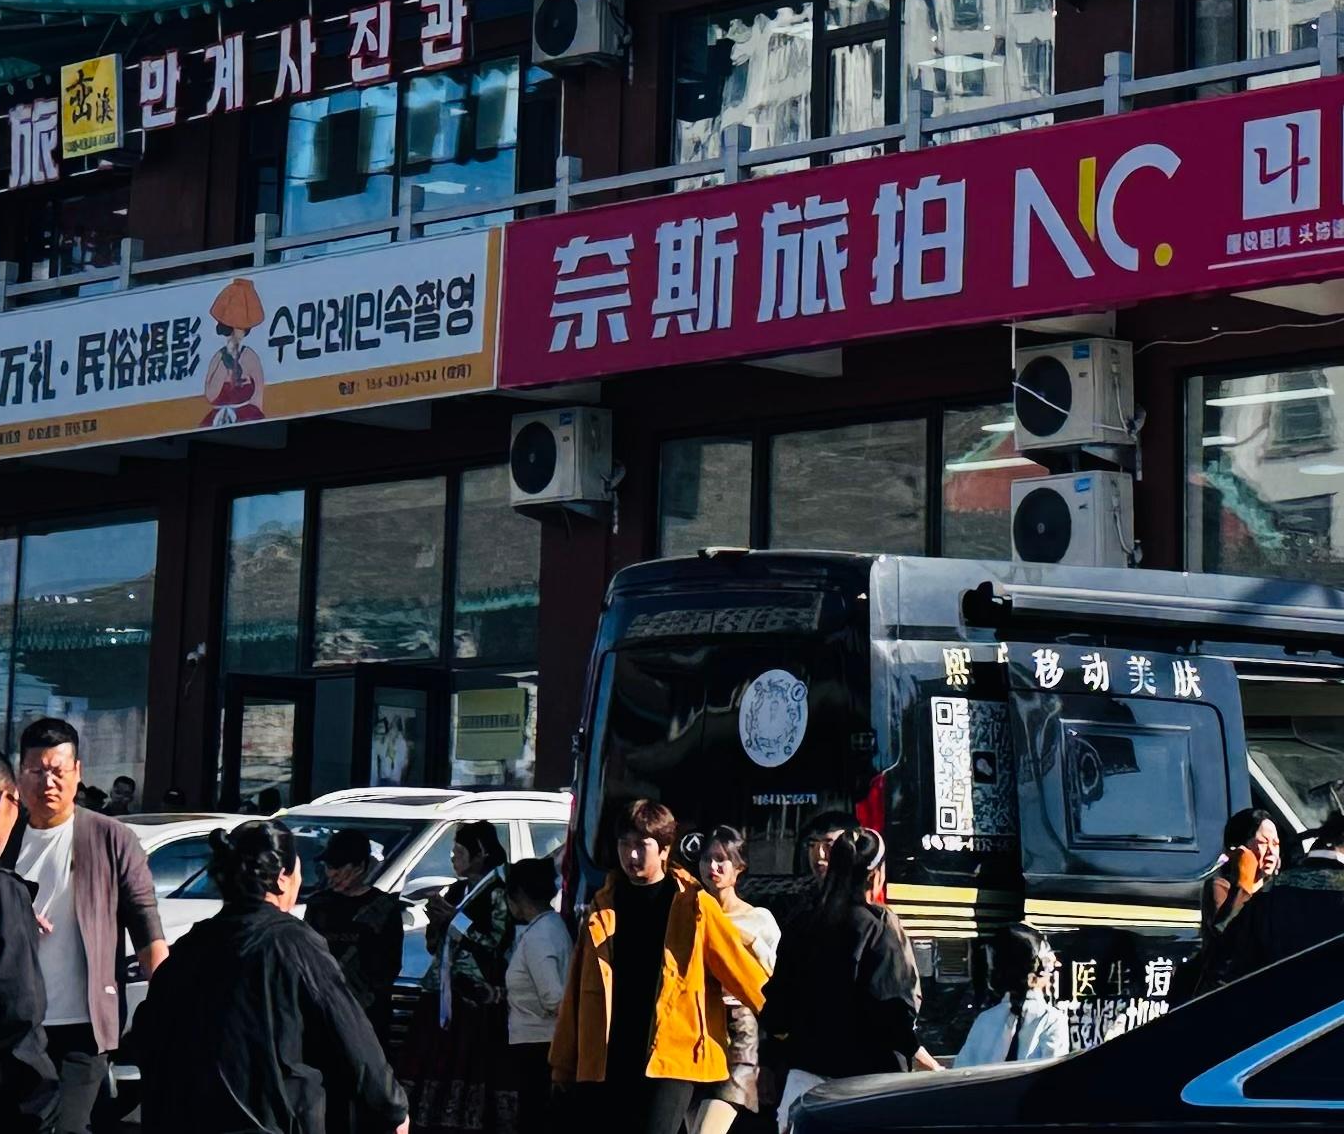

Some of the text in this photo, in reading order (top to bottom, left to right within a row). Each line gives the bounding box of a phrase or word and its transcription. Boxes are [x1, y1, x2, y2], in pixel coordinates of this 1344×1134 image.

[267, 272, 476, 365] 수만례민속촬영
[548, 172, 967, 353] 奈斯旅拍
